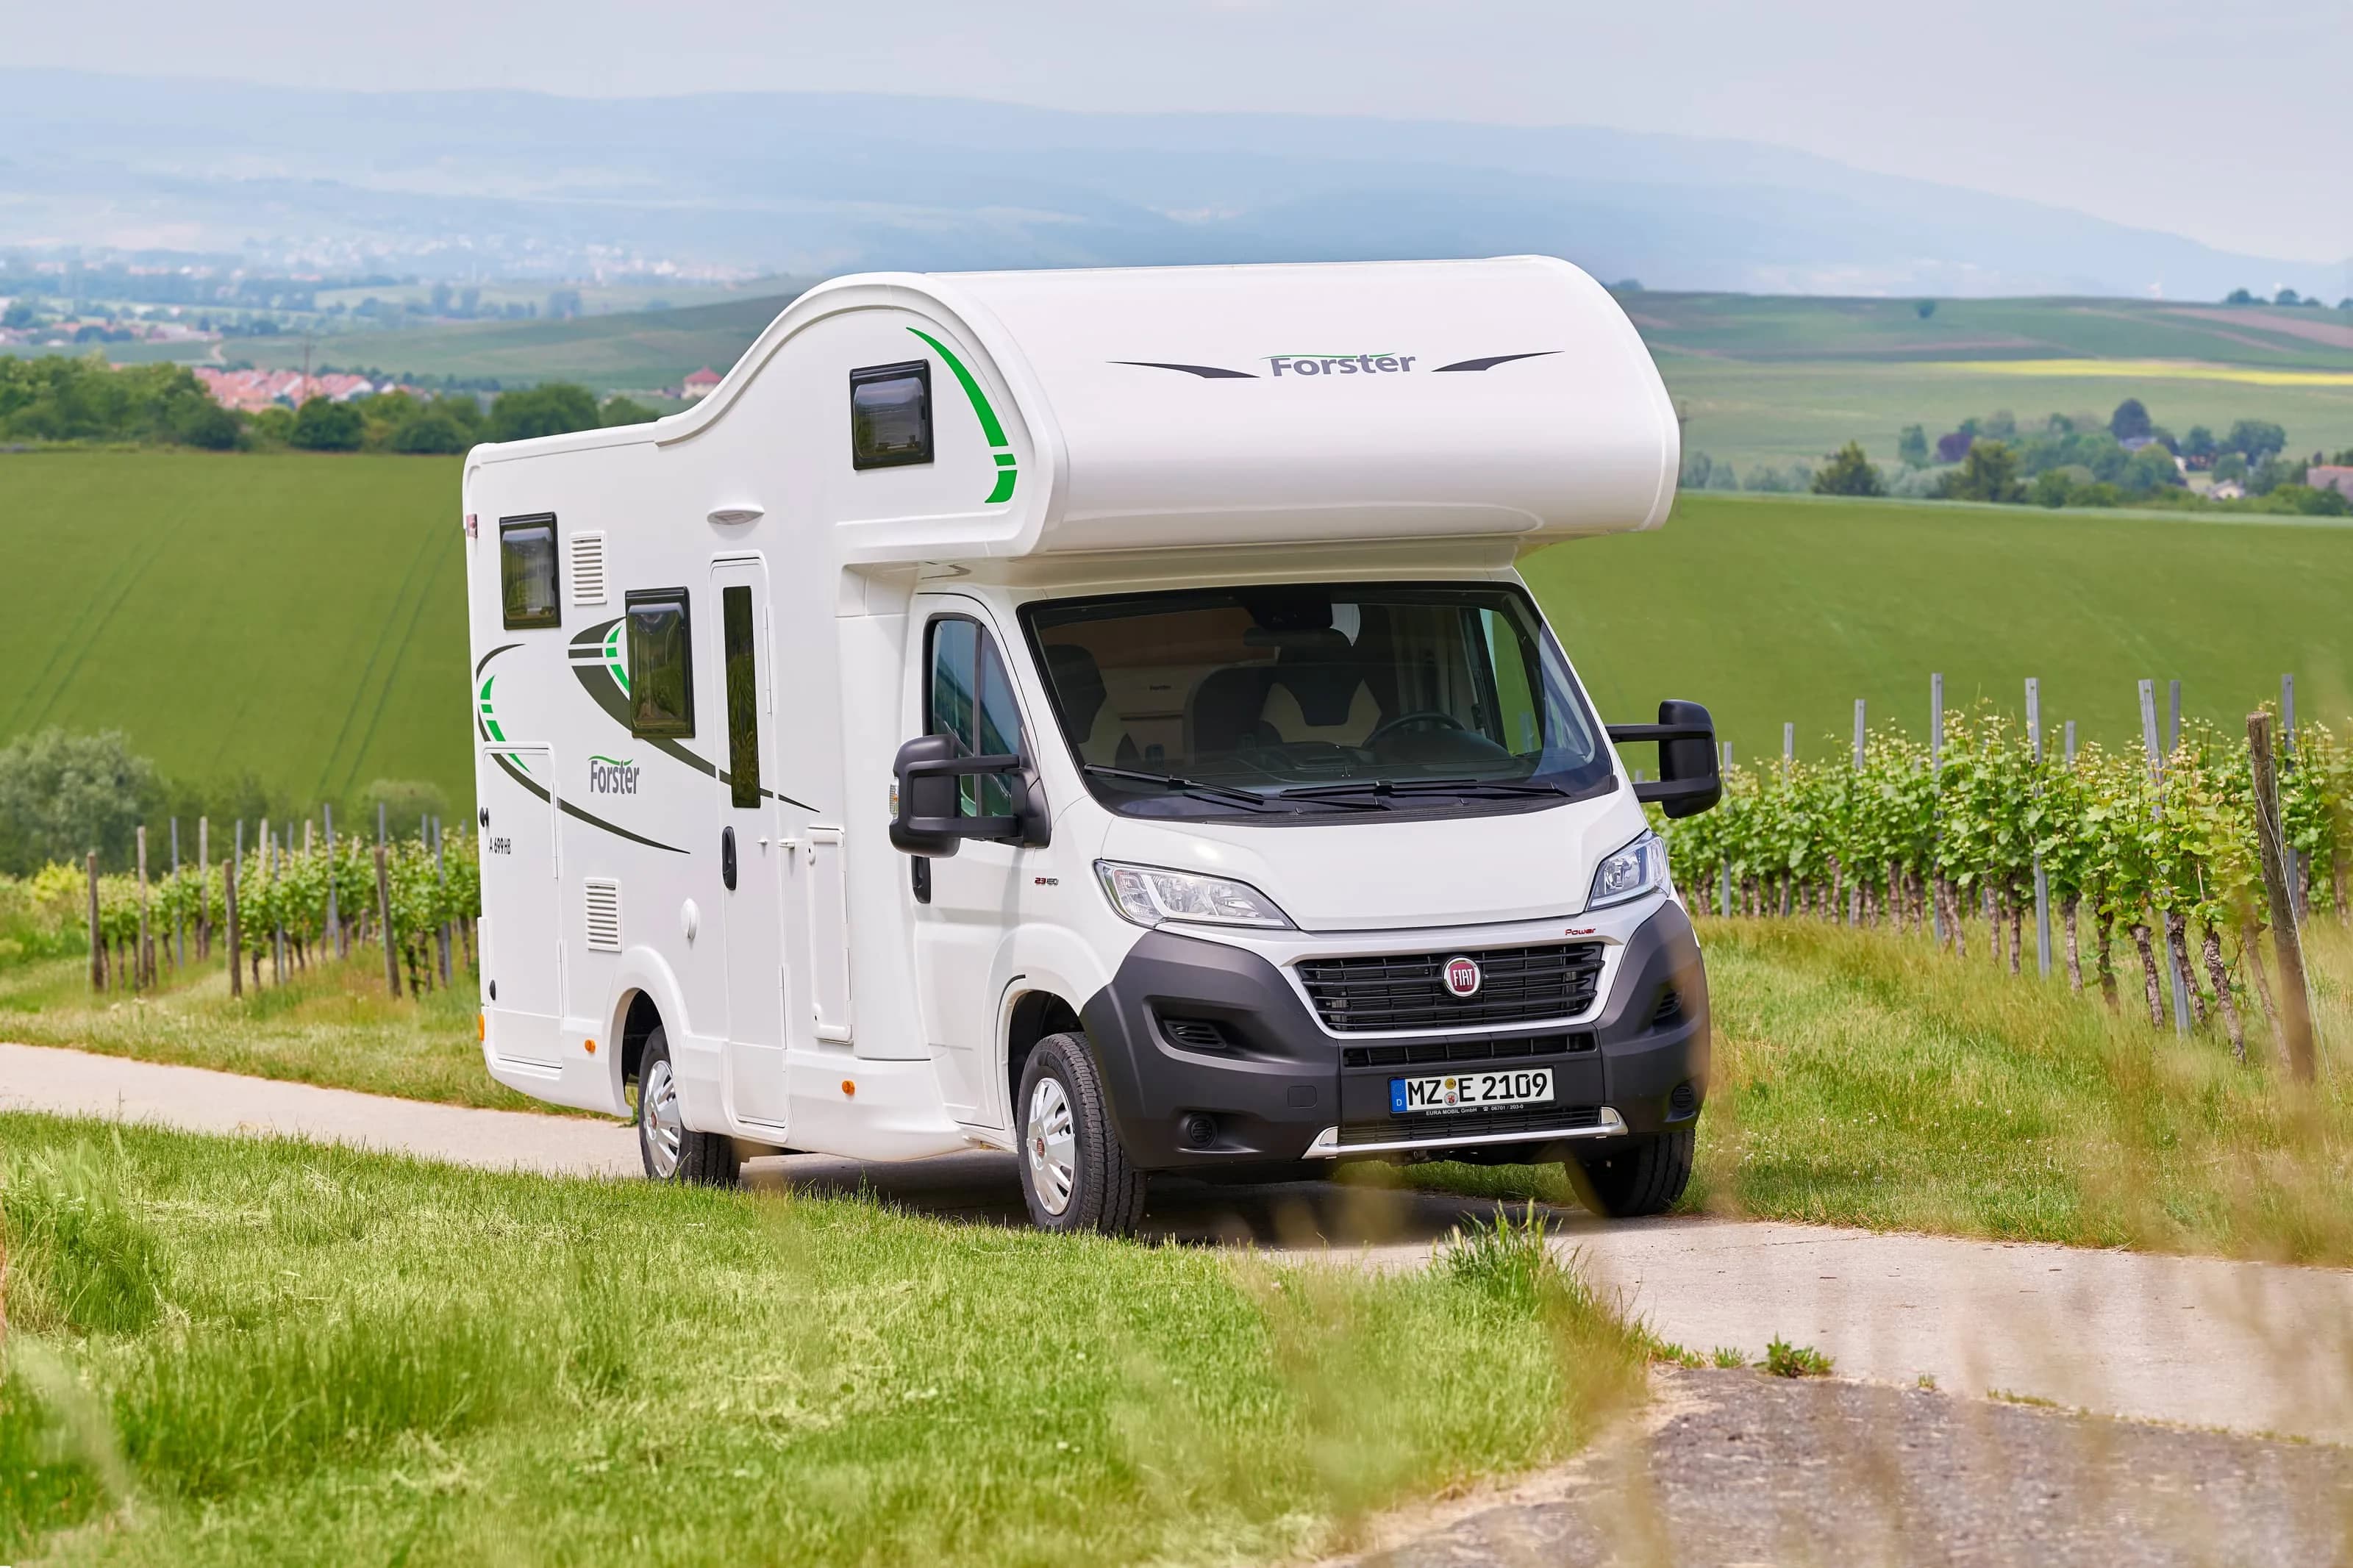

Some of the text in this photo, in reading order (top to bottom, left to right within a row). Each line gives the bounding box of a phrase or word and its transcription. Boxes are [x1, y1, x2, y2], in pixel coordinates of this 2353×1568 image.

[1271, 354, 1415, 376] Forster
[590, 759, 639, 794] Forster
[1453, 969, 1472, 986] FIAT
[1407, 1073, 1547, 1106] MZ E 2109
